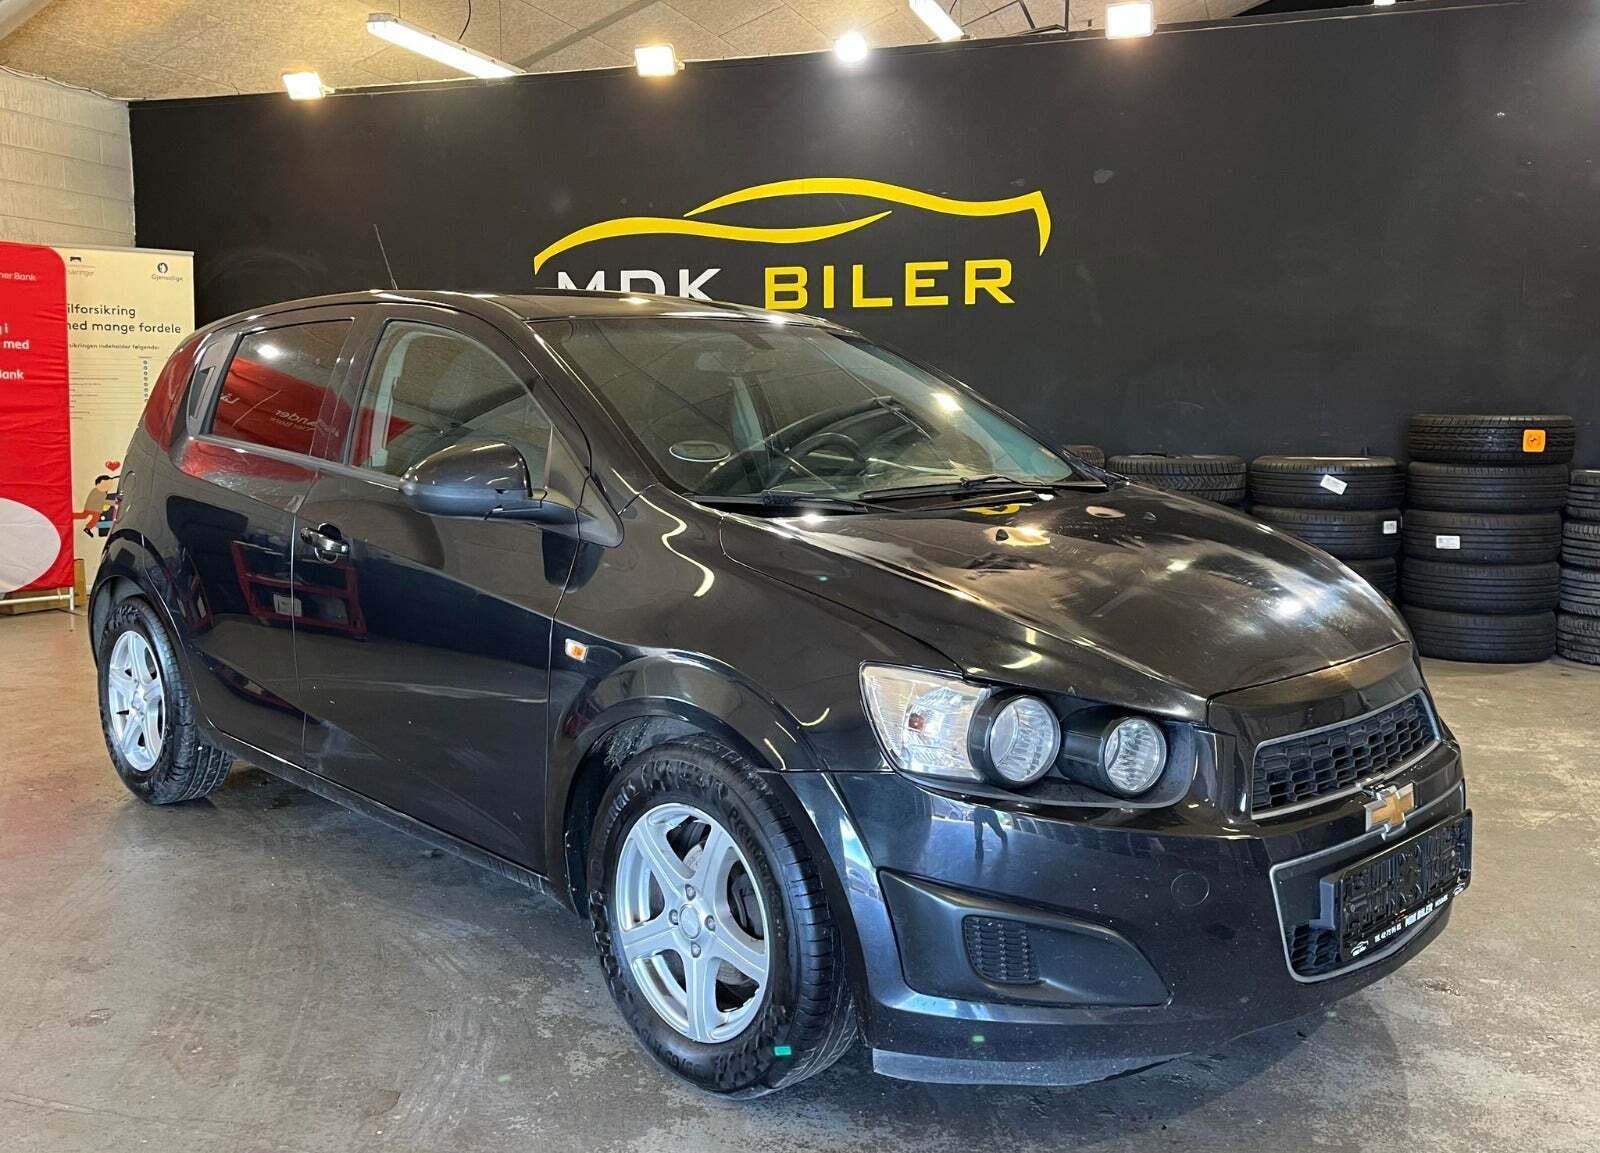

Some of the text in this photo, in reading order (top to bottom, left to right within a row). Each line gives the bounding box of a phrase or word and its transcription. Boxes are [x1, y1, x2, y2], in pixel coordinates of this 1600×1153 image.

[14, 272, 36, 281] Bank
[765, 259, 1015, 310] BILER
[67, 303, 136, 318] ilforsikring
[92, 324, 135, 334] mange
[139, 323, 181, 333] fordele
[3, 339, 30, 350] med
[0, 369, 24, 380] ank
